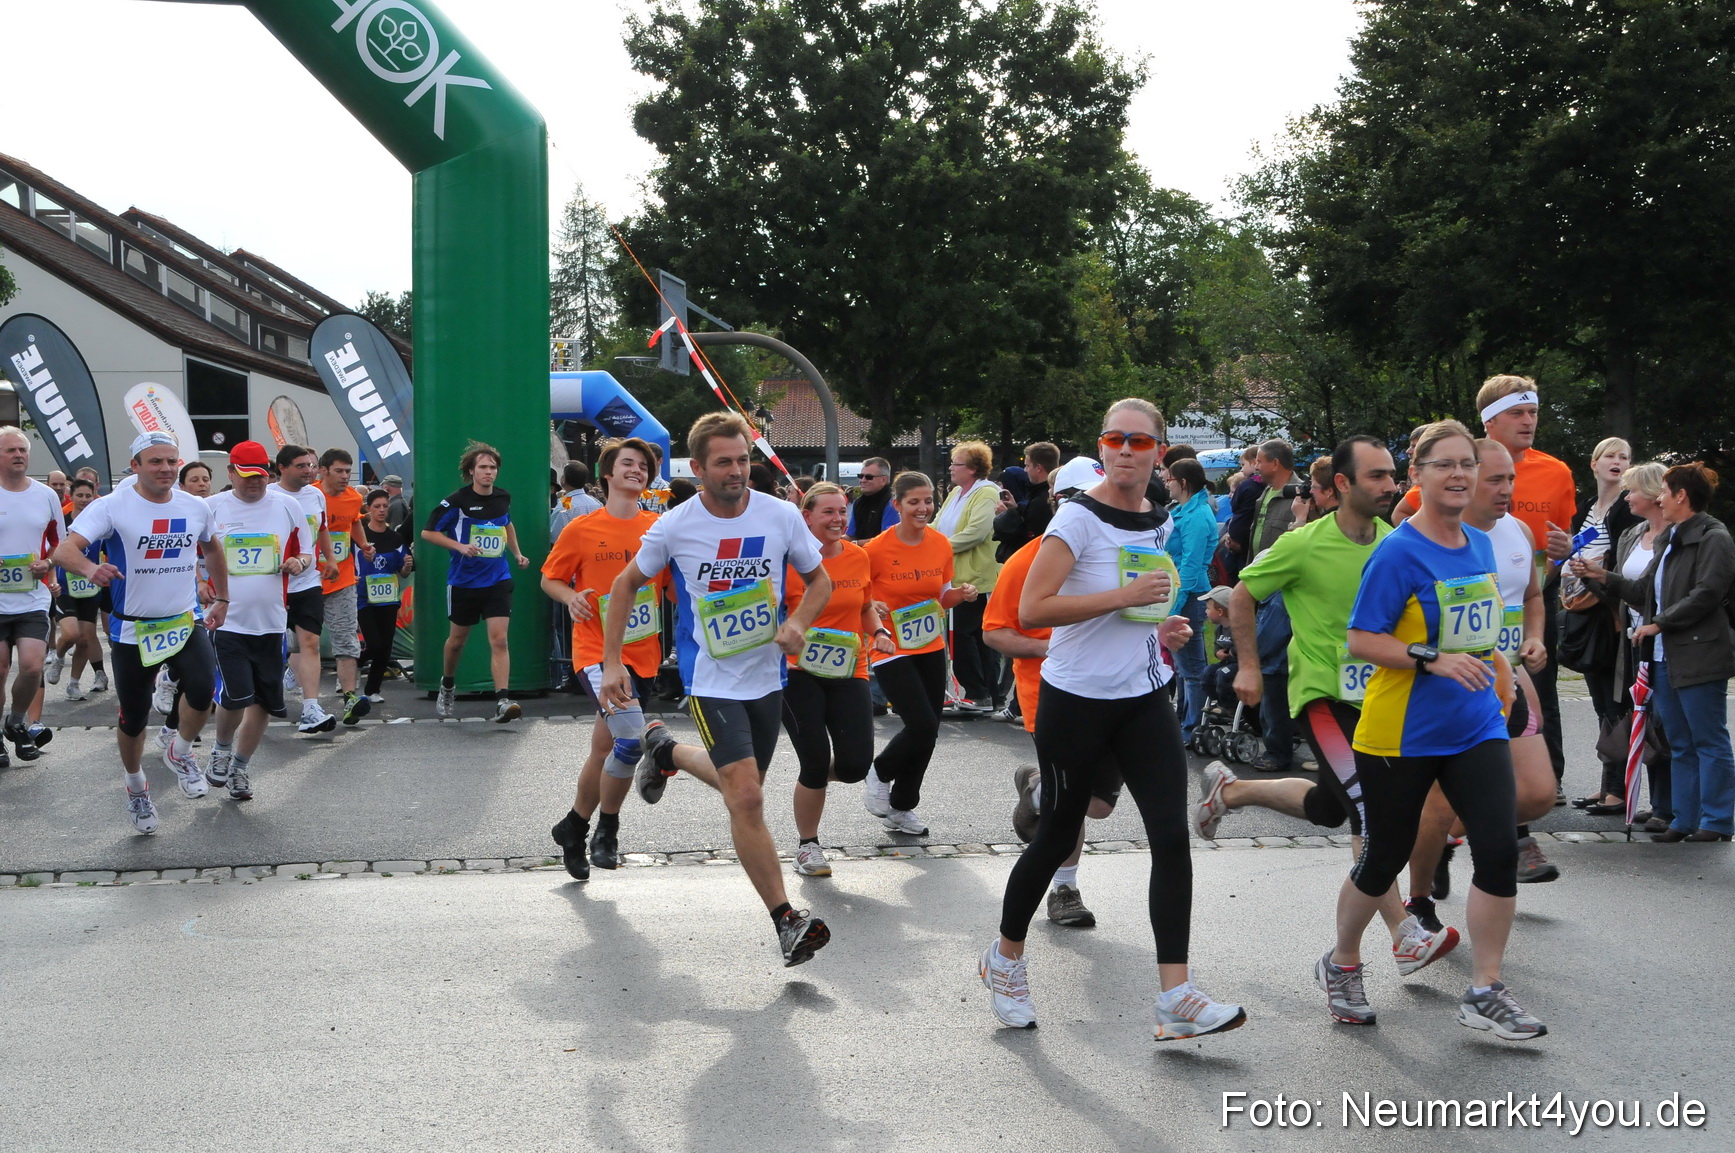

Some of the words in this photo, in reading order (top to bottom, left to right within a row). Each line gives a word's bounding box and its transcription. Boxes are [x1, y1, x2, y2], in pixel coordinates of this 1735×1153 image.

[137, 534, 193, 550] PERRAS
[475, 536, 500, 549] 300
[237, 548, 262, 565] 37
[595, 552, 623, 562] EURO
[713, 559, 761, 568] AUTOHAUS
[0, 567, 23, 583] 36
[134, 564, 194, 575] www.perras.de
[697, 558, 771, 580] PERRAS
[891, 572, 914, 581] EURO
[920, 568, 942, 577] POLES
[71, 580, 96, 591] 304
[370, 584, 392, 597] 308
[836, 579, 861, 589] POLES
[707, 603, 771, 640] 1265
[1450, 600, 1493, 635] 767
[901, 615, 935, 641] 570
[142, 628, 188, 653] 1266
[805, 643, 847, 667] 573
[1345, 664, 1374, 691] 36
